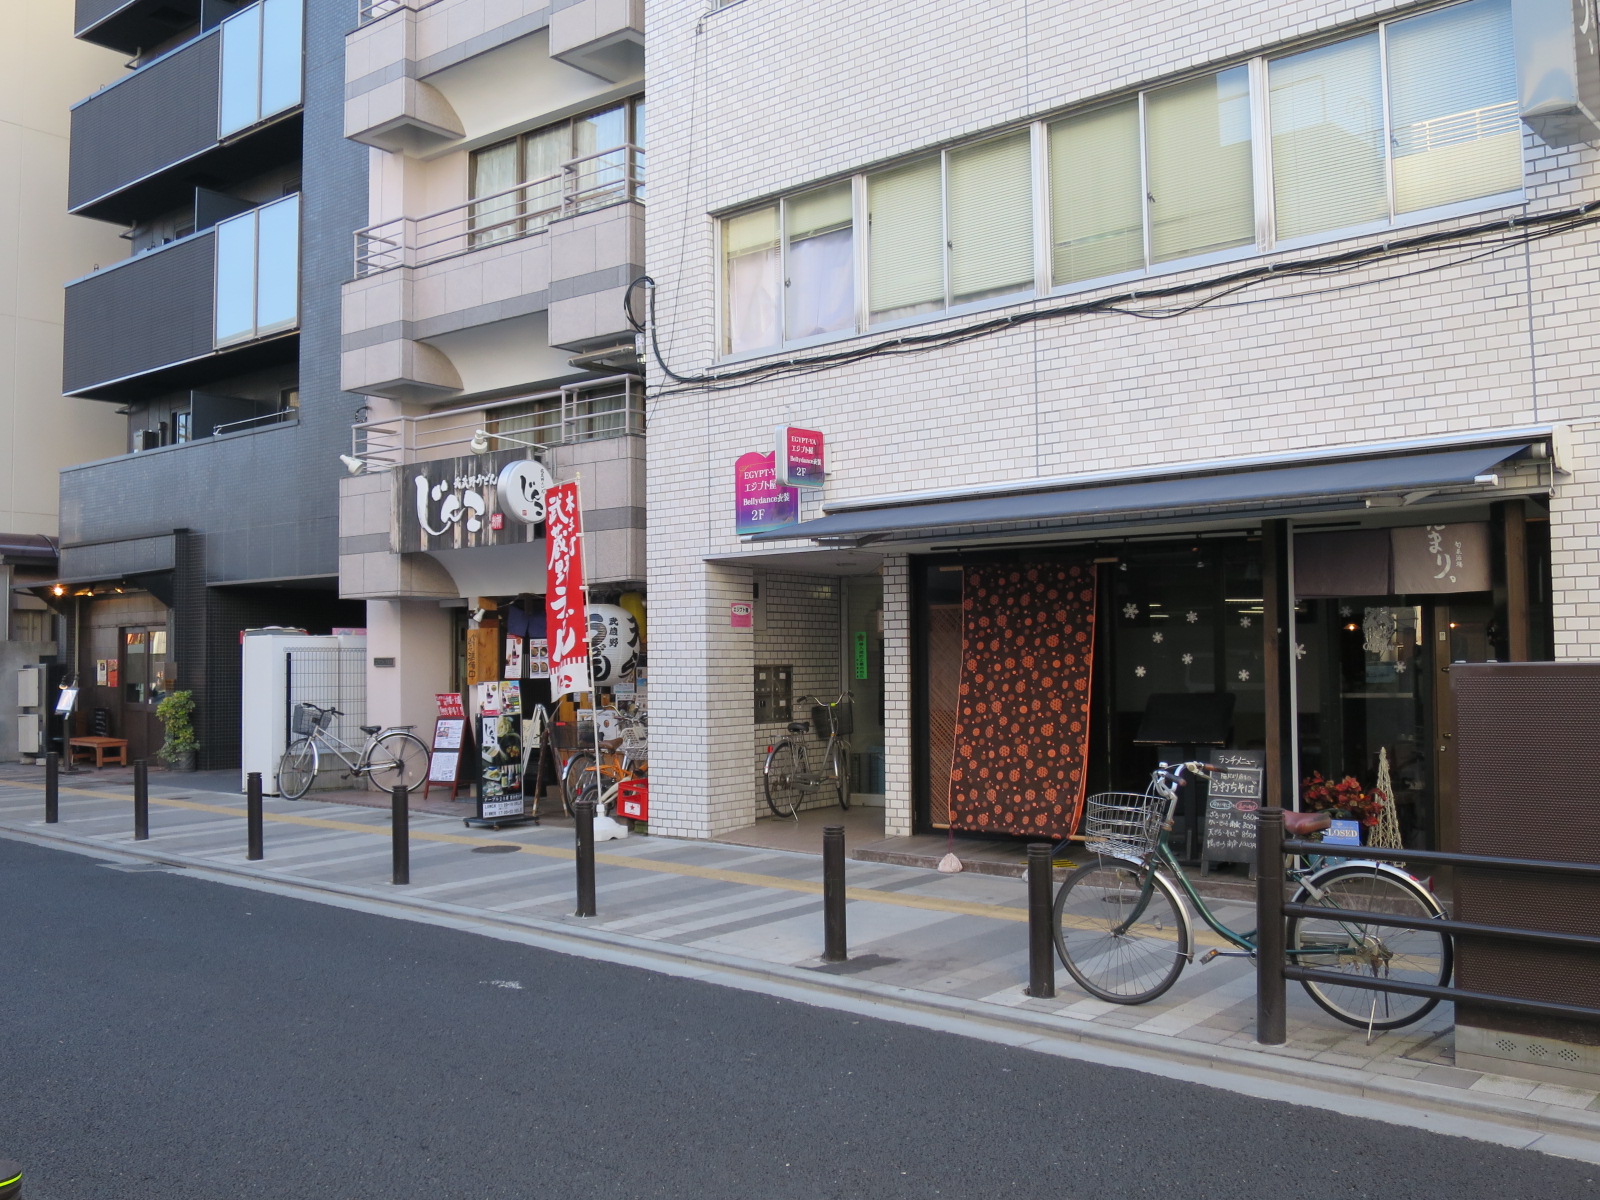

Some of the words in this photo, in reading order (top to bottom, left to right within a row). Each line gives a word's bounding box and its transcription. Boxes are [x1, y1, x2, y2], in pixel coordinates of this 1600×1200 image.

[791, 435, 817, 446] EGYPT-YA
[744, 468, 776, 480] EGYPT-Y
[796, 466, 807, 477] 2F
[751, 508, 766, 521] 2F
[1426, 525, 1457, 583] まり。
[1218, 755, 1256, 766] ランチメニュー
[1325, 827, 1358, 838] LOSED
